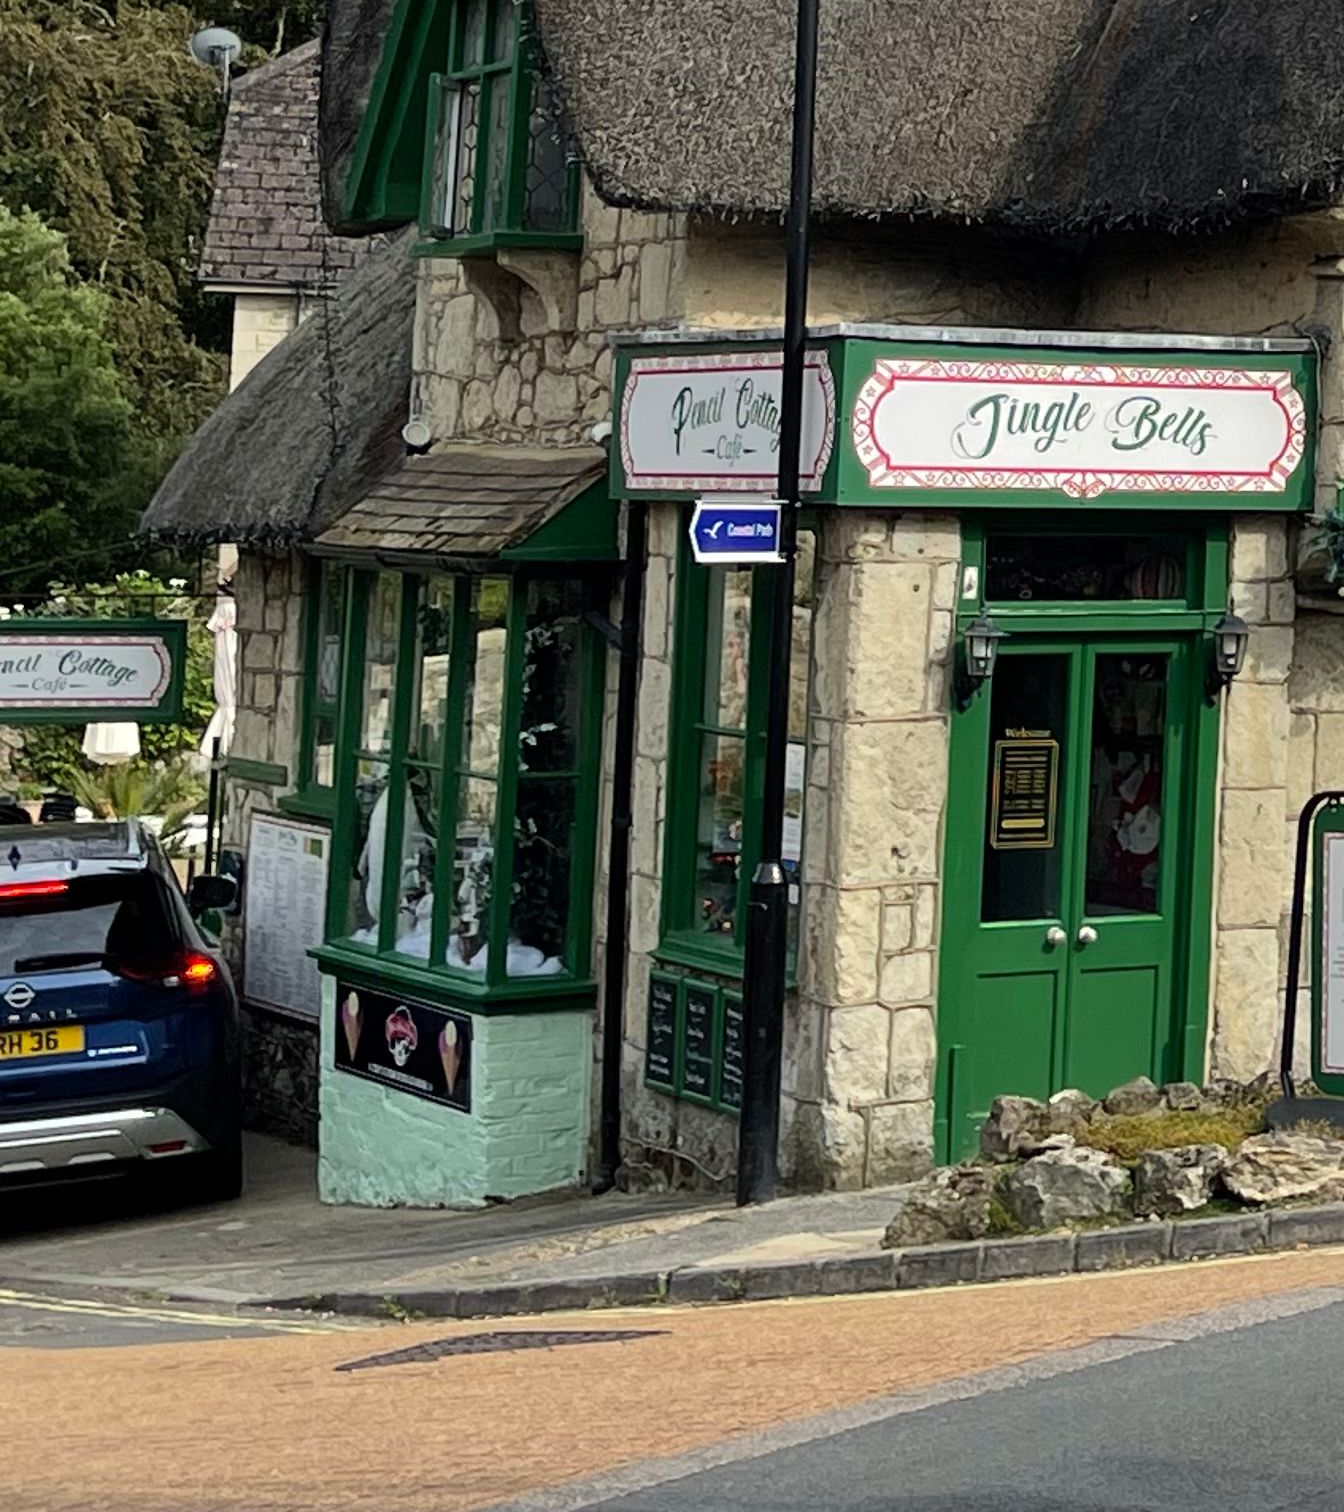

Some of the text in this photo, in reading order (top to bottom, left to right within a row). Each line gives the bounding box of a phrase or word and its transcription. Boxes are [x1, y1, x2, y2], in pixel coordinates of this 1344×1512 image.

[672, 378, 782, 456] Pencil Cottag
[951, 392, 1218, 459] Jingle Bells
[716, 433, 743, 467] Café
[31, 677, 67, 694] Café
[57, 649, 138, 687] Cottage
[30, 1030, 59, 1051] 36
